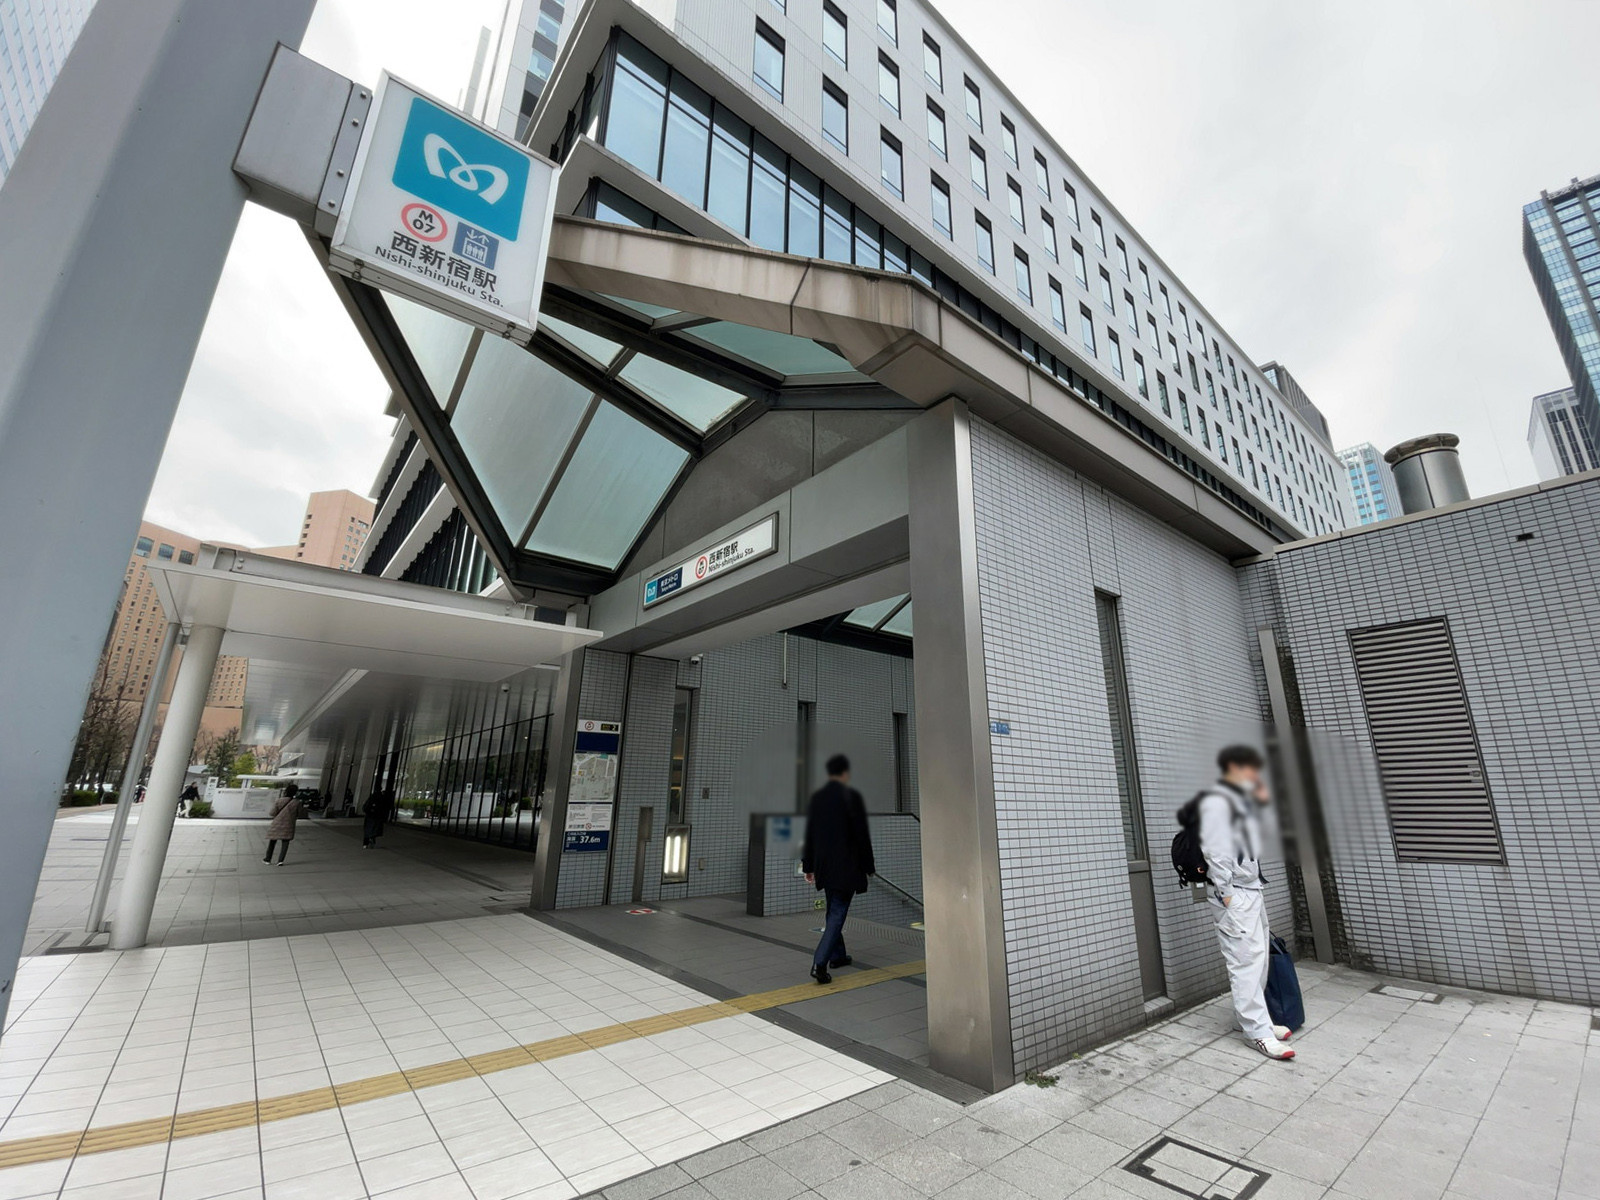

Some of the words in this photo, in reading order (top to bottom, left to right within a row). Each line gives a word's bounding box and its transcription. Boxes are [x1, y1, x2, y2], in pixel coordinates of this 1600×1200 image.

[418, 210, 434, 223] M
[412, 219, 436, 234] 07
[390, 231, 497, 292] 西新宿駅
[375, 246, 476, 296] Nishi-shinjuku
[479, 290, 504, 308] Sta.
[709, 541, 739, 565] 西新宿駅
[579, 836, 601, 844] 37.6m
